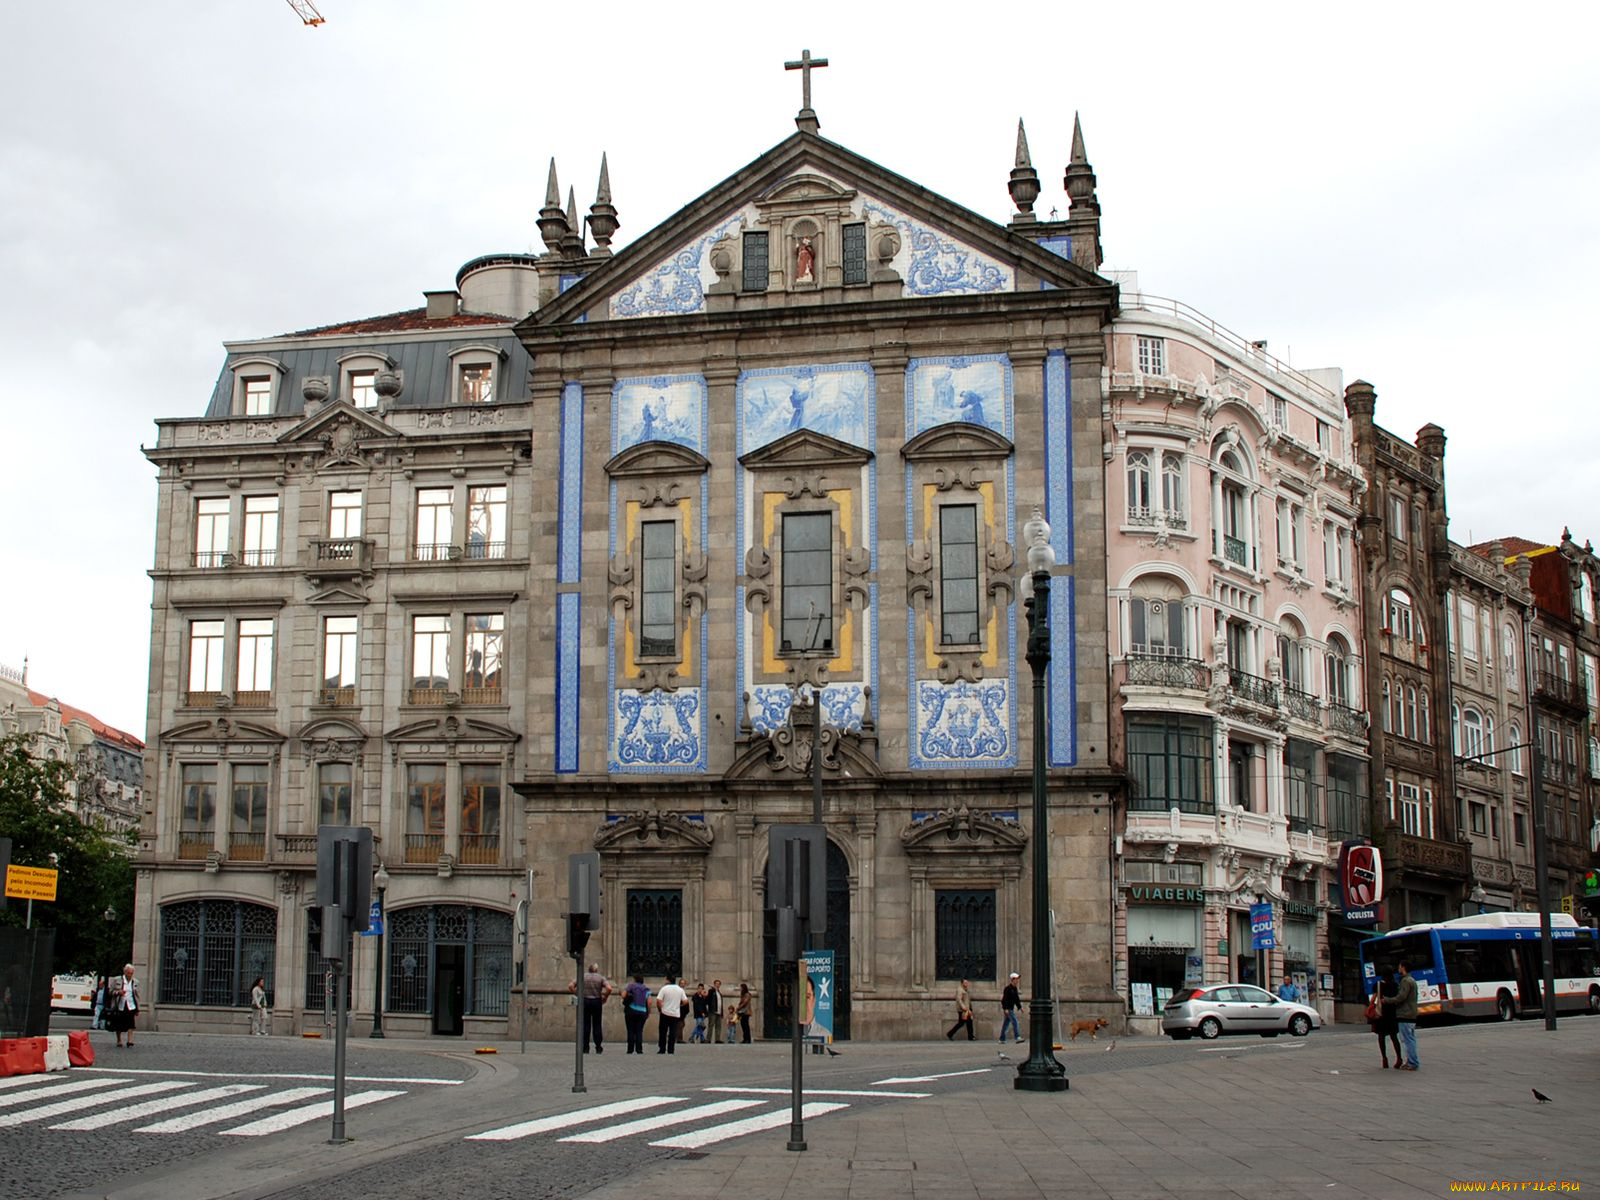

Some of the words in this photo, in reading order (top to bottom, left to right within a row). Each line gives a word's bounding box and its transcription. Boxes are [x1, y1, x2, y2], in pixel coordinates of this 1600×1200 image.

[9, 868, 31, 876] Pedimos
[32, 890, 55, 898] Passeio
[1132, 887, 1204, 901] VIAGENS
[1347, 911, 1375, 919] OCULISTA
[1251, 921, 1273, 933] CDU
[813, 957, 831, 967] FORÇAS
[815, 965, 831, 973] PORTO
